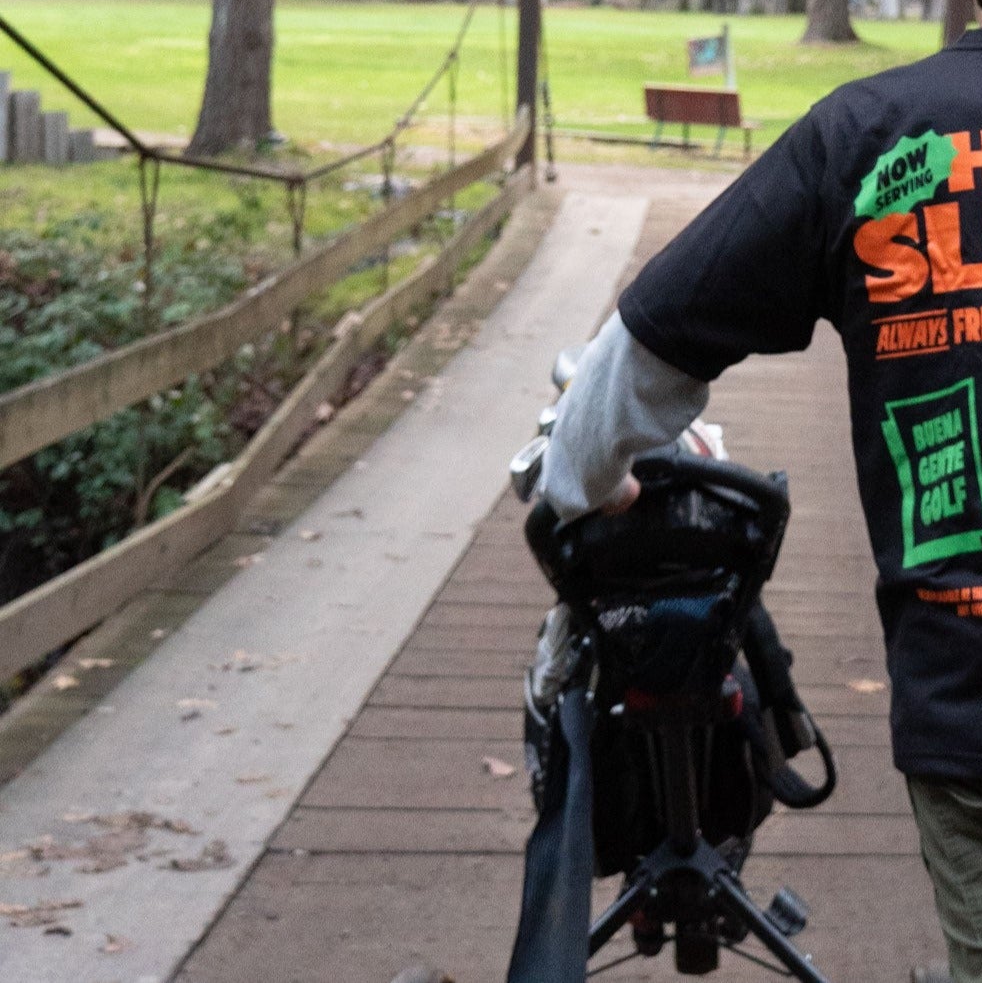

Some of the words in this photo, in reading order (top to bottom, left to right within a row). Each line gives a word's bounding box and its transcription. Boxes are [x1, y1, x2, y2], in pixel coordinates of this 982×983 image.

[876, 142, 928, 192] NOW
[875, 168, 933, 212] SERVING
[876, 318, 948, 353] ALWAYS
[912, 408, 963, 452] BUENA
[919, 440, 965, 486] GENTE
[921, 475, 967, 526] GOLF
